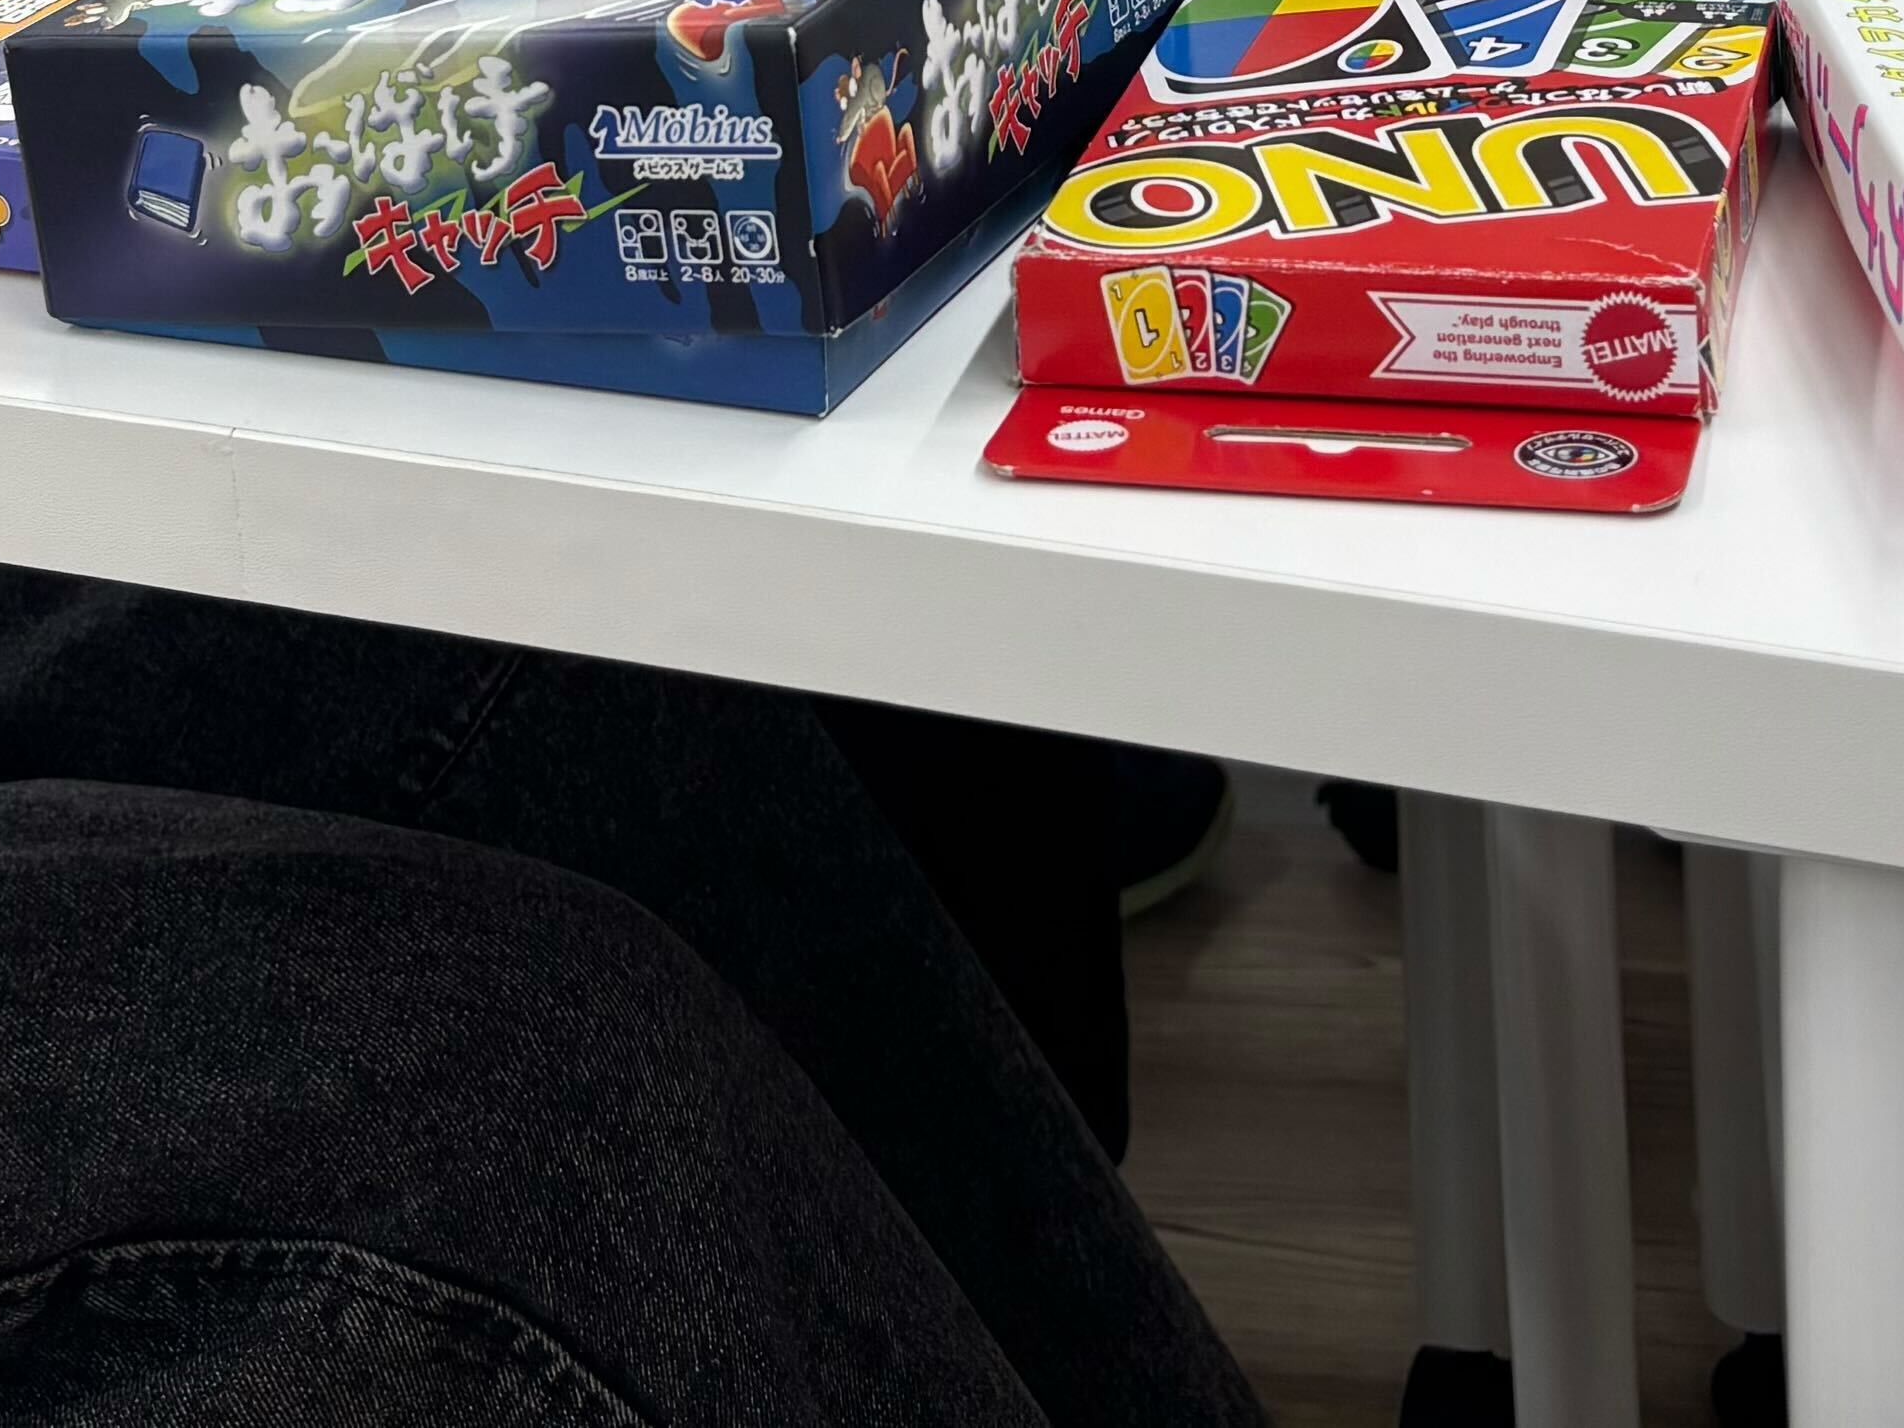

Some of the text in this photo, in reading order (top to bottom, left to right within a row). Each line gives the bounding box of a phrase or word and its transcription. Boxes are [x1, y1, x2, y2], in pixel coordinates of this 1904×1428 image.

[1467, 33, 1519, 67] 4
[1579, 38, 1640, 66] 3
[1680, 46, 1753, 73] 2
[622, 104, 773, 145] Möbius
[228, 55, 552, 252] おばけ
[633, 158, 744, 179] メビウスゲームス
[1039, 114, 1708, 248] UNO
[352, 161, 588, 295] キャッチ
[1134, 308, 1160, 348] 1
[1498, 316, 1562, 332] through
[1436, 332, 1563, 349] next generation
[1583, 329, 1677, 365] MATTEL
[1195, 351, 1208, 370] 2
[1220, 354, 1233, 371] 3
[1432, 349, 1563, 369] Empowering the
[1060, 405, 1146, 420] Games
[1050, 428, 1127, 443] MATTEL
